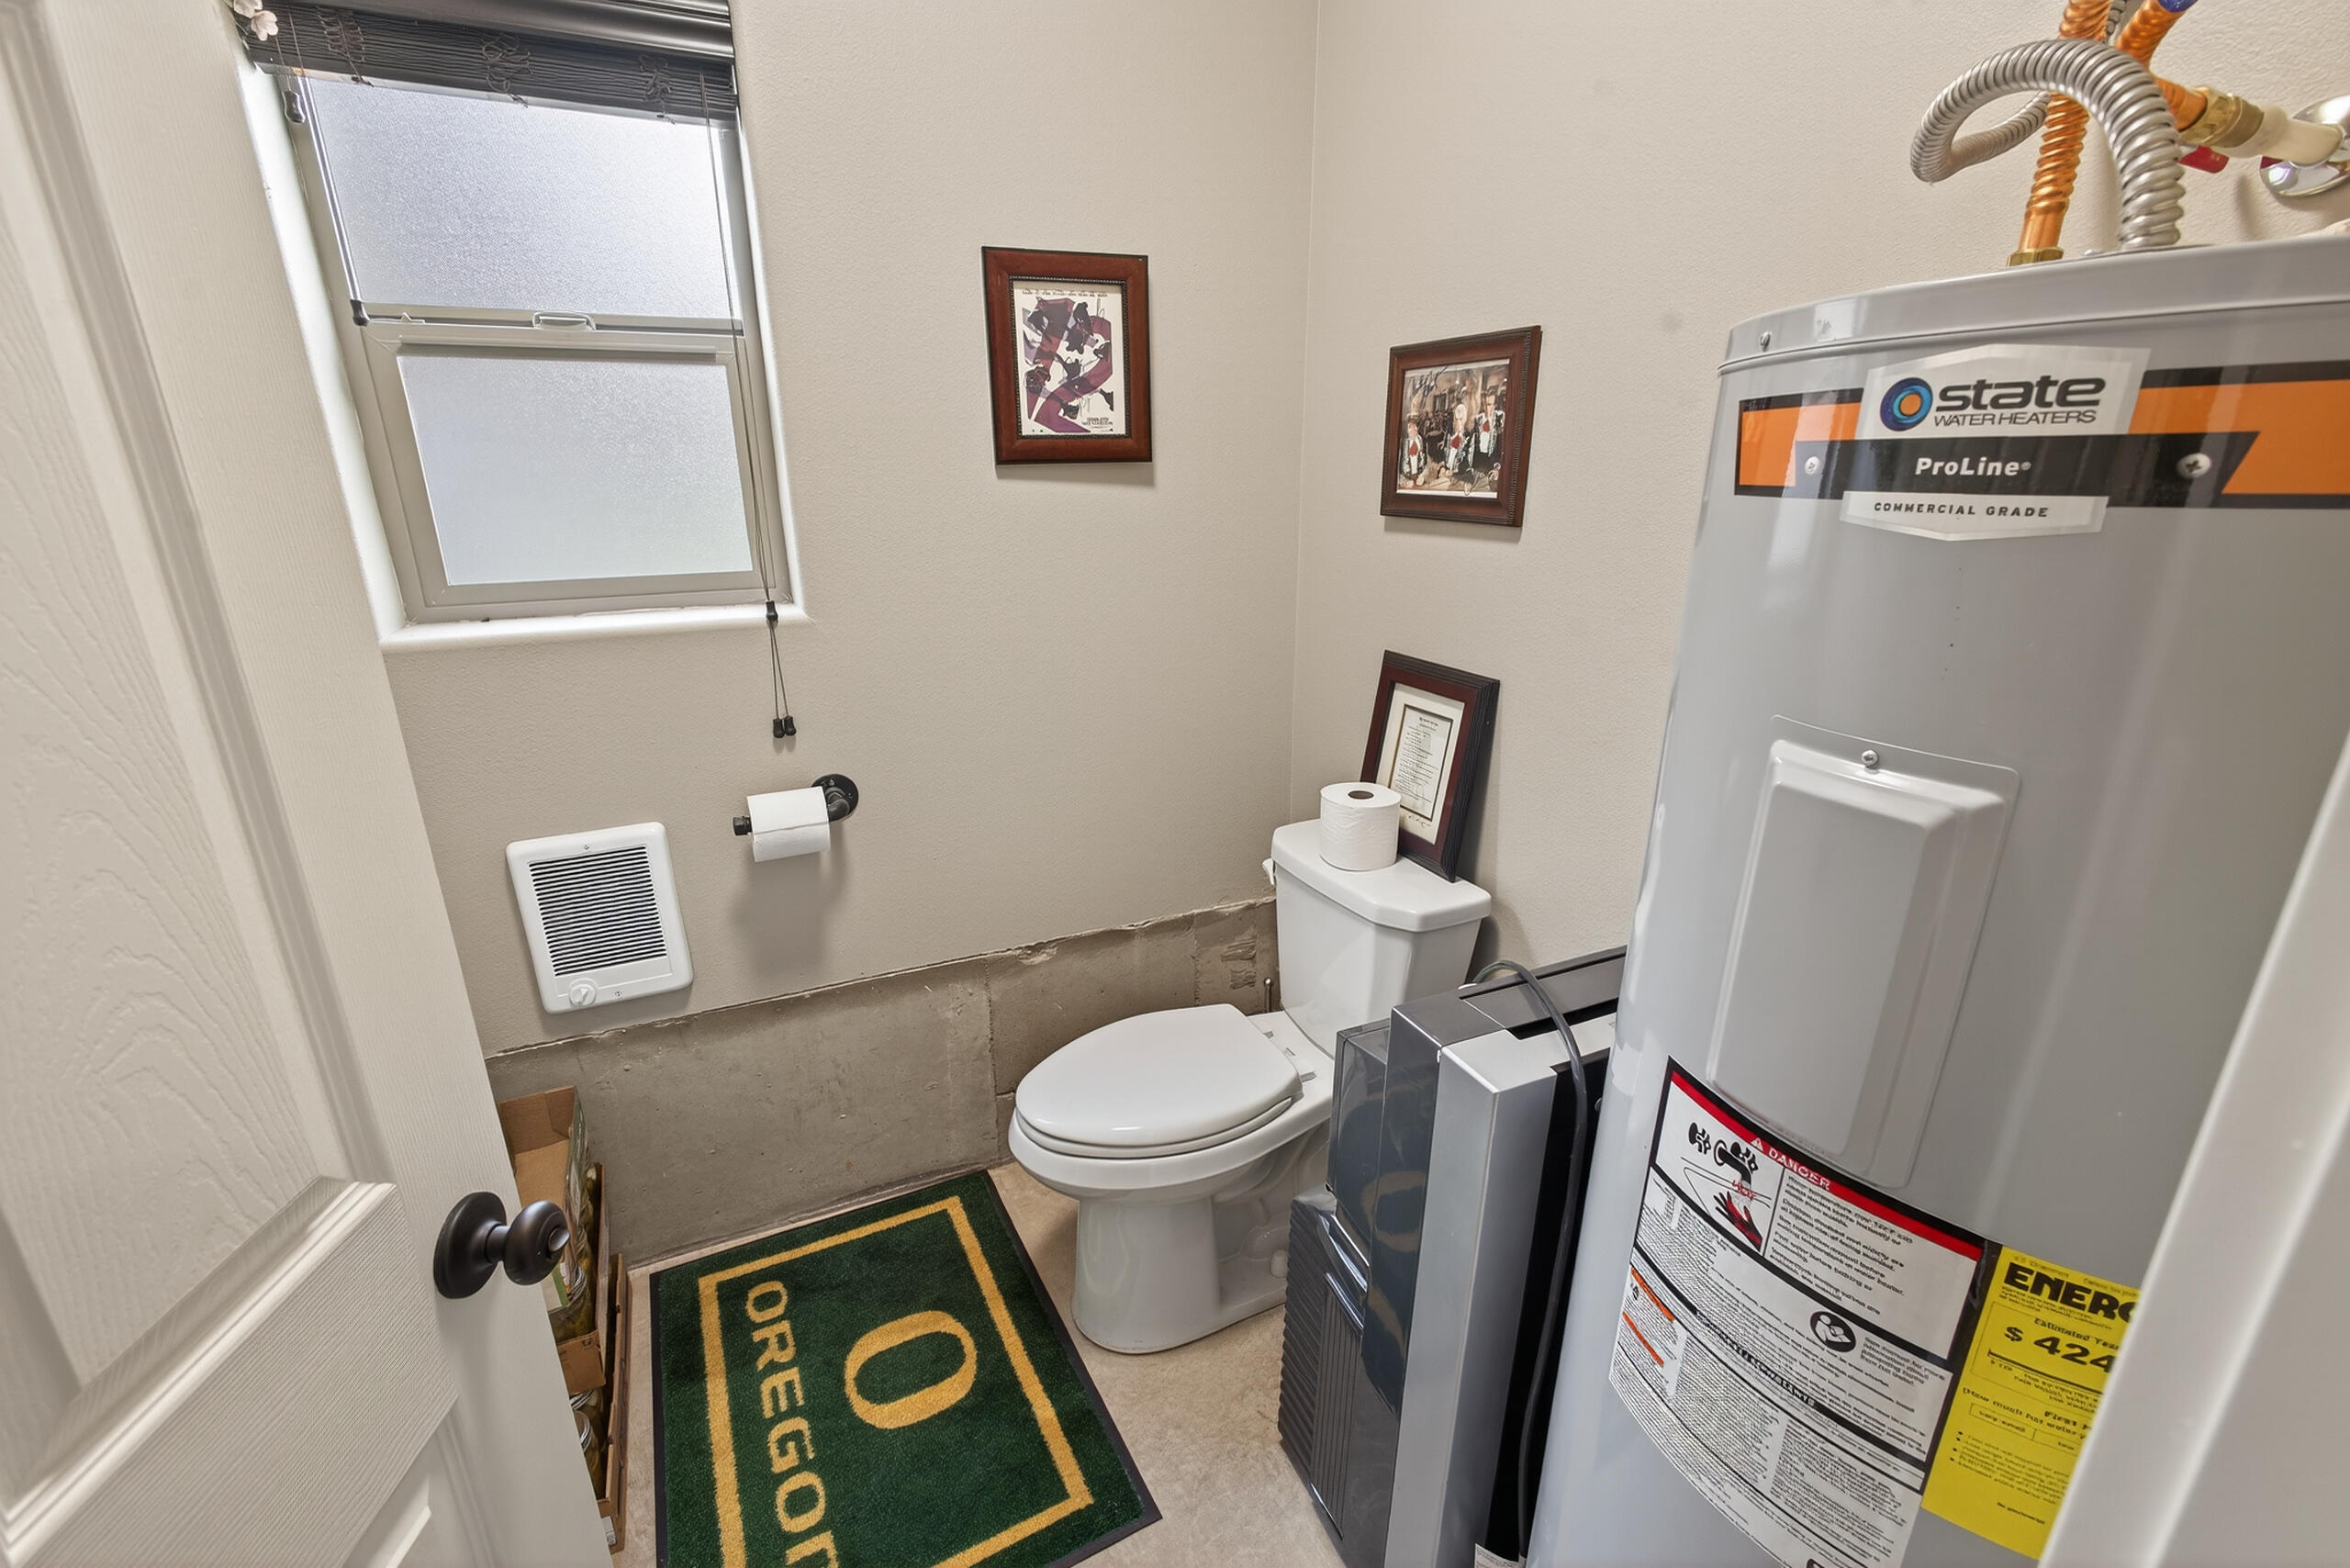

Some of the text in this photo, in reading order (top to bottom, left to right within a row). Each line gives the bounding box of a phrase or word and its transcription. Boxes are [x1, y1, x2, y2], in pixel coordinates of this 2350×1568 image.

[1935, 375, 2106, 411] state
[1934, 409, 2098, 427] WATER HEATERS
[1874, 502, 2049, 518] COMMERCIAL GRADE
[1768, 1148, 1830, 1191] DANGER
[2004, 1326, 2024, 1343] $
[844, 1309, 978, 1429] O
